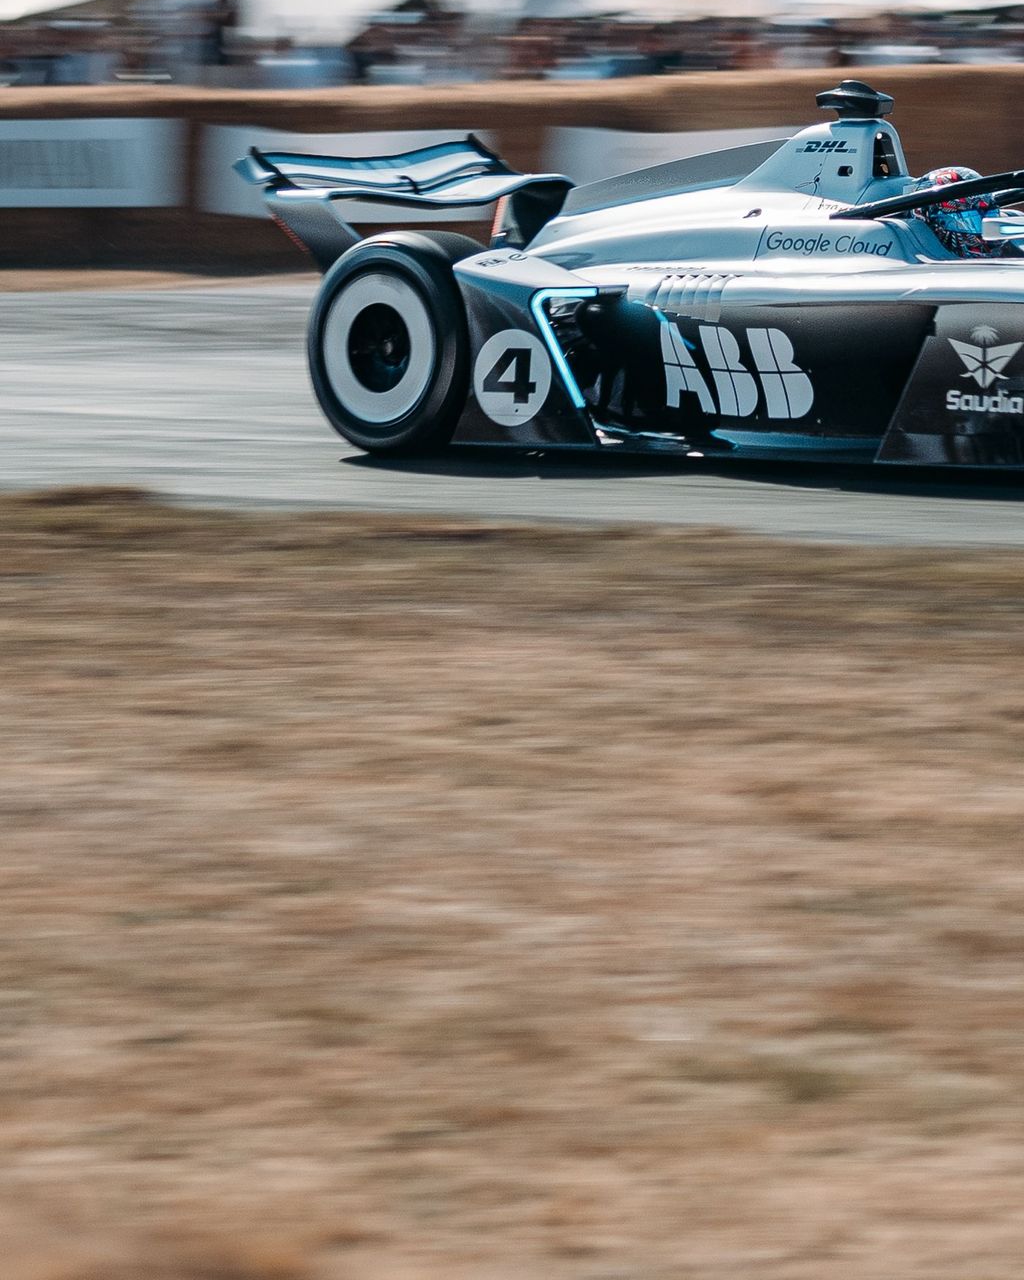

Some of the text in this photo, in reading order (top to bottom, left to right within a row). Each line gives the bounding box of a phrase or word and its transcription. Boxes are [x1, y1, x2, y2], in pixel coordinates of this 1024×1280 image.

[803, 140, 850, 154] DHL
[766, 231, 894, 257] Google Cloud
[482, 347, 537, 404] 4
[659, 322, 815, 419] ABB
[945, 389, 1024, 415] Saudia
